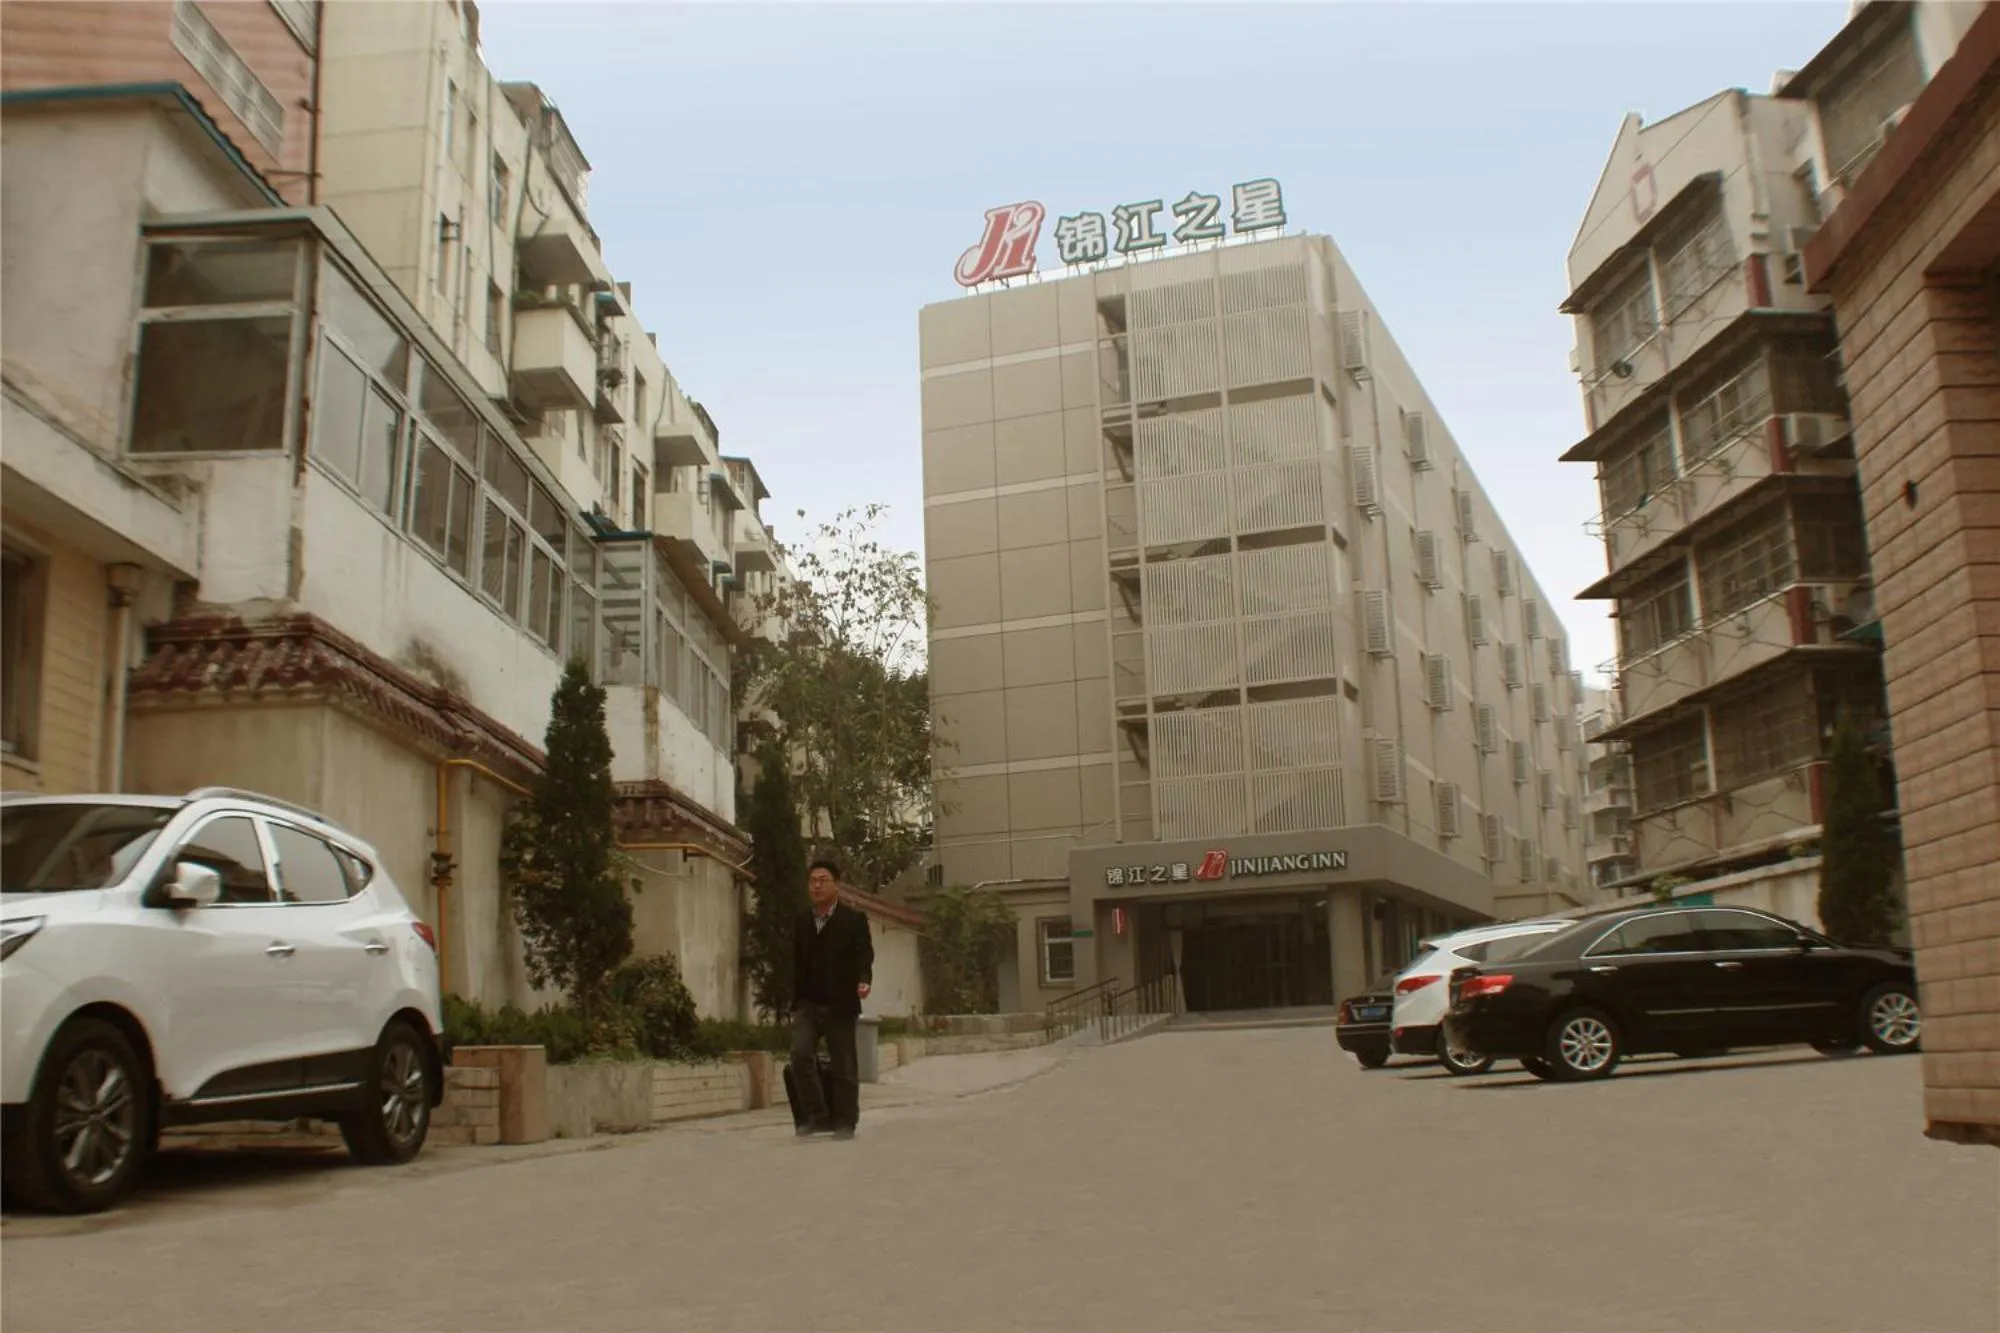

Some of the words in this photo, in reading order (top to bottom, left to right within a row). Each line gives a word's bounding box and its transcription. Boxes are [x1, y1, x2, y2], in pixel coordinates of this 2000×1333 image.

[1054, 178, 1286, 264] 锦江之星
[1107, 864, 1190, 885] 锦江之星
[1230, 856, 1310, 876] JINJIANG
[1311, 852, 1347, 869] INN
